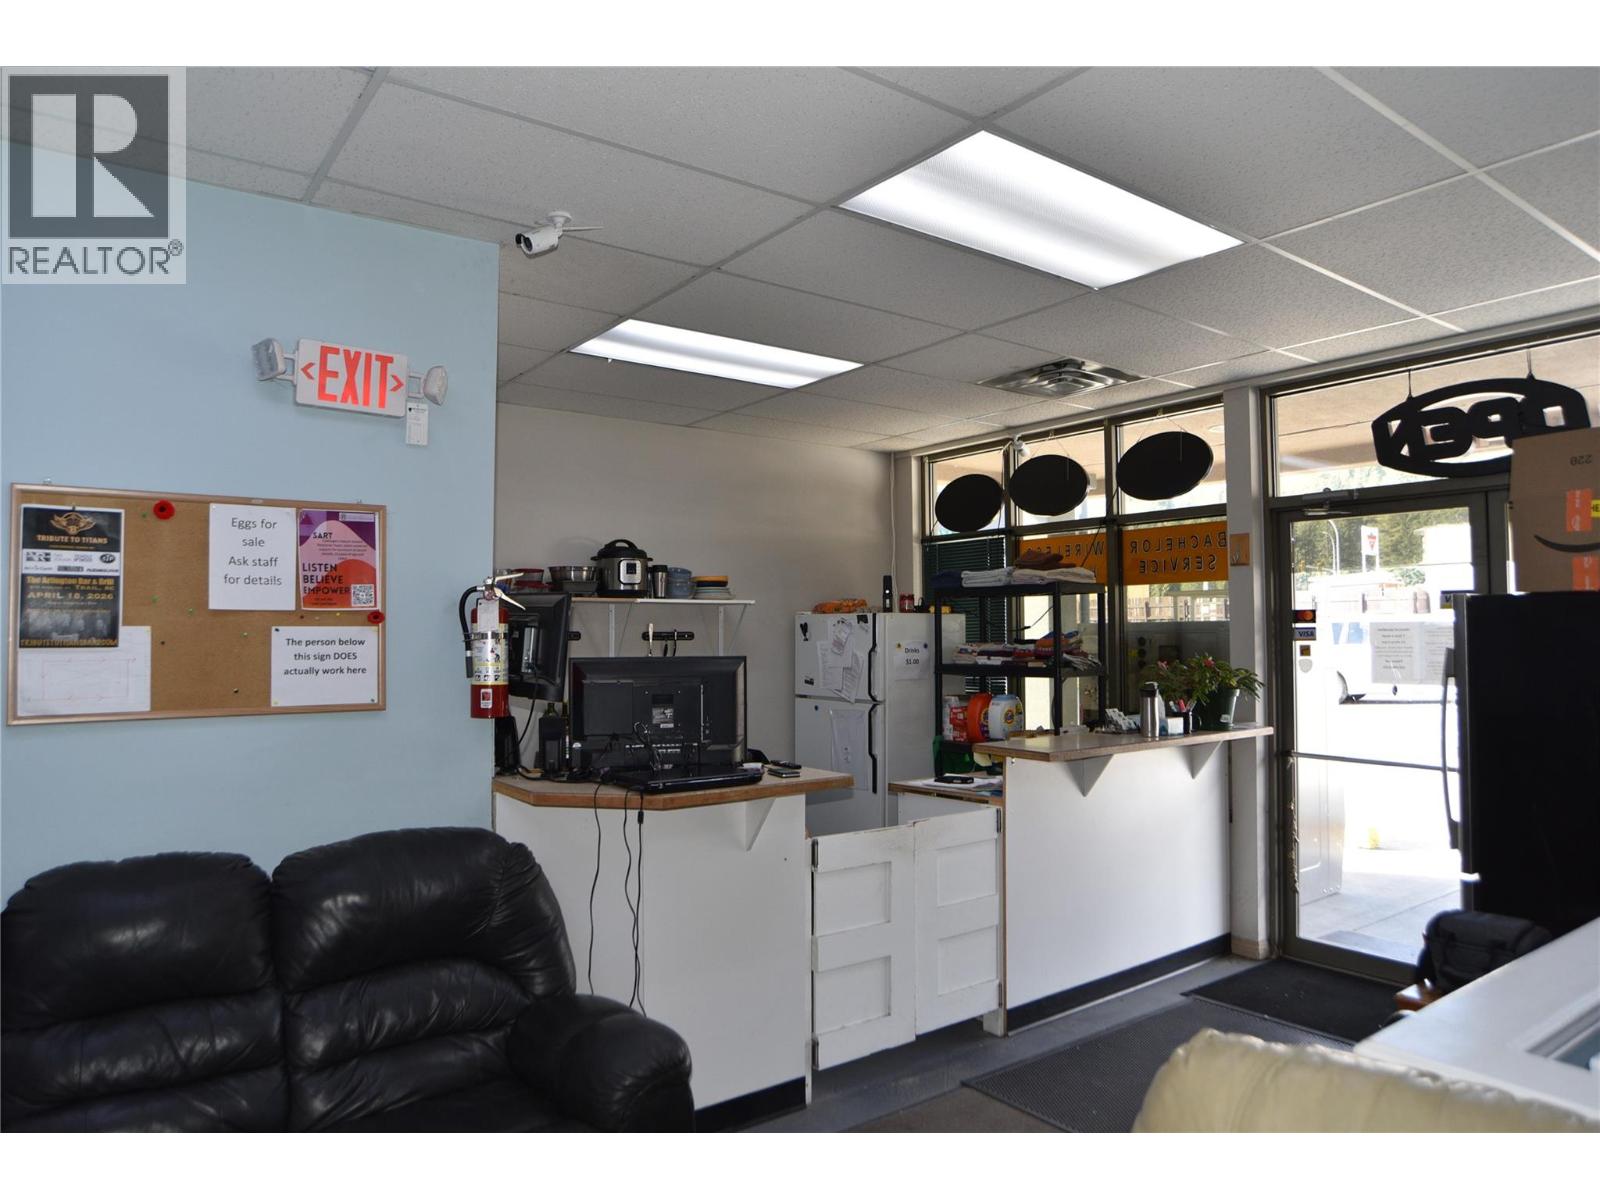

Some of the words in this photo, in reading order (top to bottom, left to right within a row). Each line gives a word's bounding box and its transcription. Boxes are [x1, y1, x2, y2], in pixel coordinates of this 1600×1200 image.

[317, 345, 394, 409] EXIT
[231, 517, 257, 530] Eggs
[261, 518, 278, 529] for
[36, 534, 69, 543] TRIBUTE
[81, 536, 108, 544] TITANS
[242, 537, 265, 547] sale
[228, 556, 249, 566] Ask
[252, 557, 279, 567] staff
[302, 563, 337, 572] LISTEN
[224, 574, 240, 585] for
[243, 575, 283, 586] details
[303, 574, 344, 584] BELIEVE
[27, 591, 64, 599] APRIL
[86, 592, 114, 600] 2026
[303, 586, 351, 595] EMPOWER
[285, 638, 302, 646] The
[305, 639, 336, 647] person
[338, 638, 366, 646] below
[313, 653, 331, 662] sign
[333, 652, 358, 660] DOES
[284, 666, 320, 676] actually
[322, 666, 345, 675] work
[346, 666, 367, 674] here
